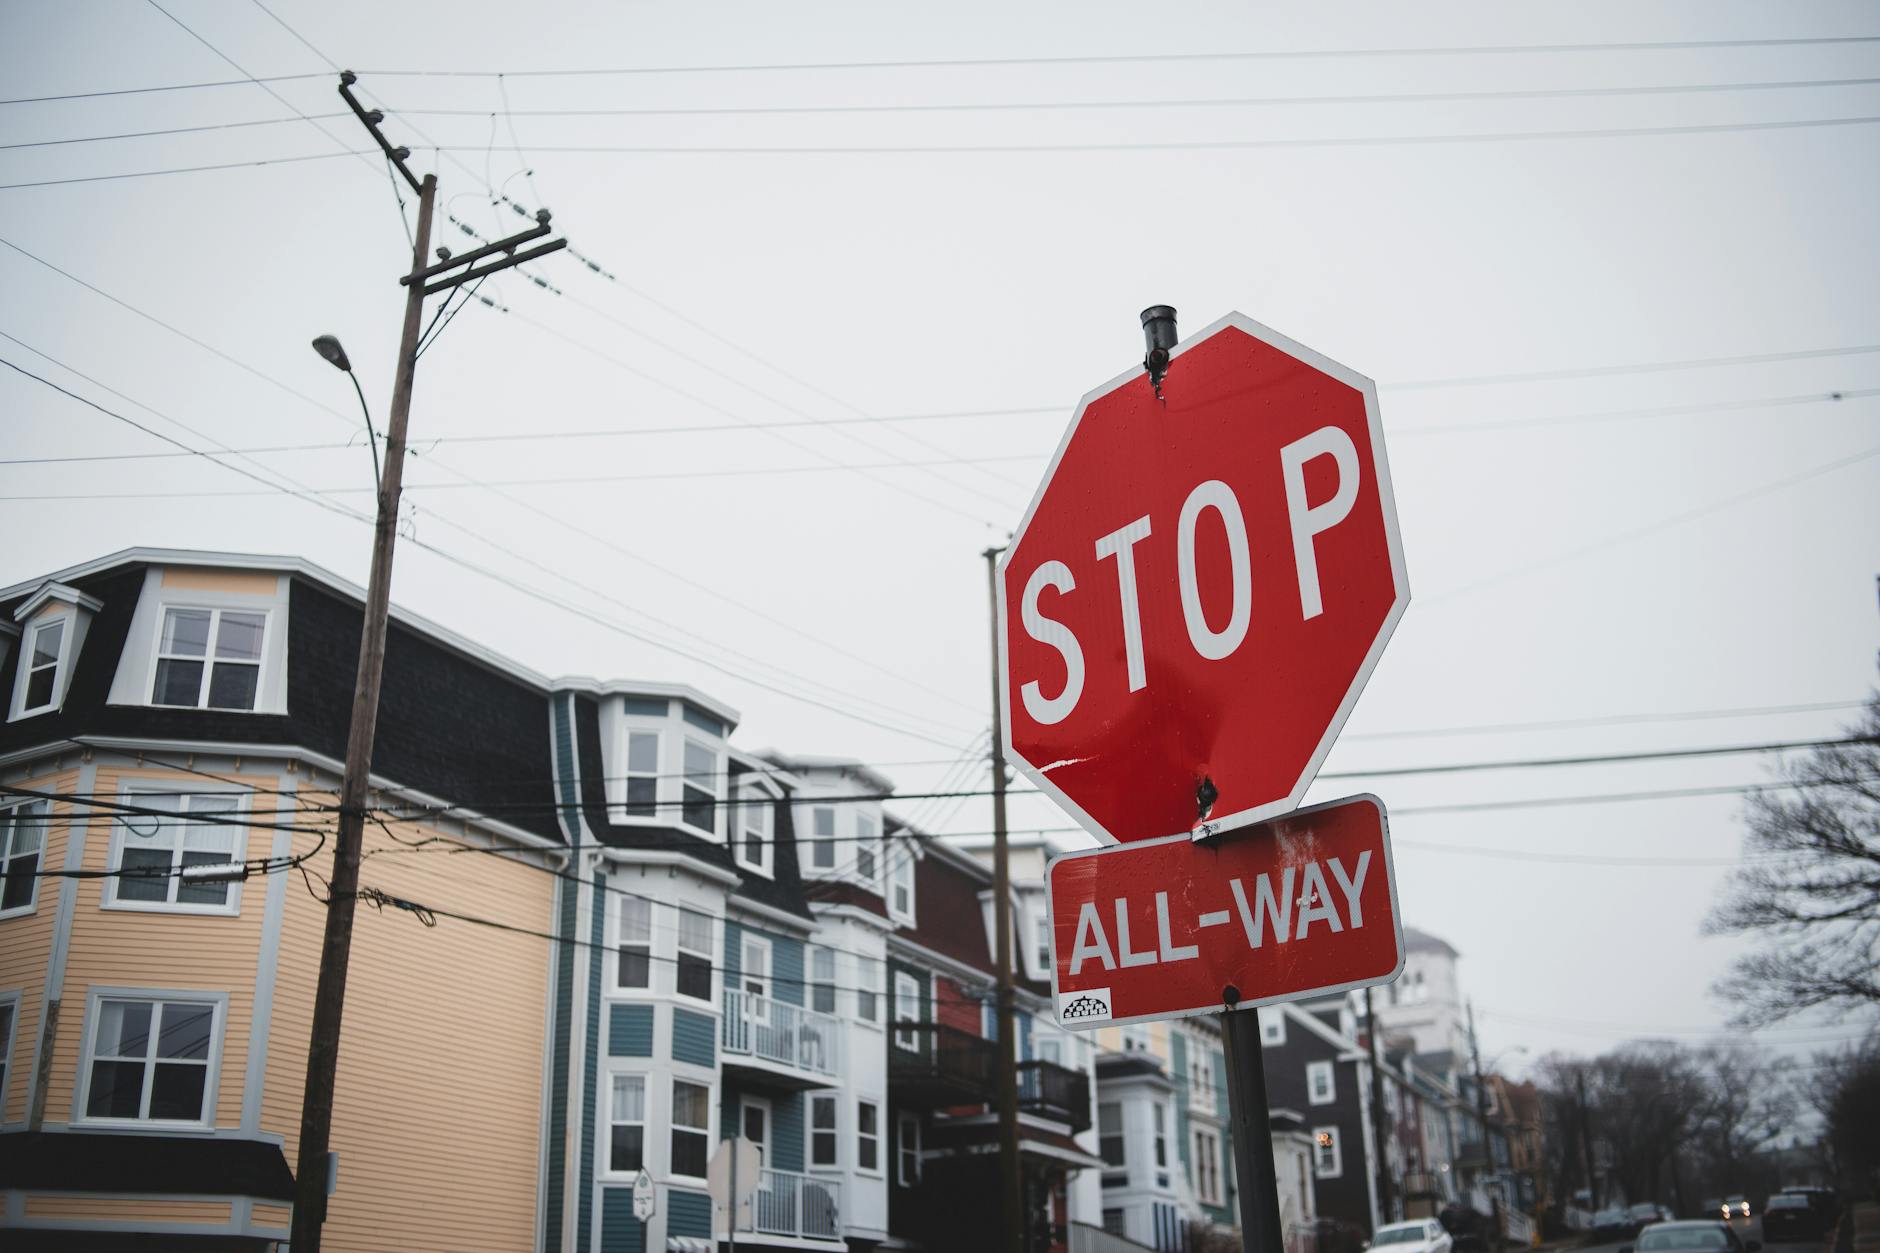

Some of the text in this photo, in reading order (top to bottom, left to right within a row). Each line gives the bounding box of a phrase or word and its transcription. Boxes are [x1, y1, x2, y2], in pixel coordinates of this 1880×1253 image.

[1020, 425, 1361, 725] STOP
[1068, 849, 1373, 976] ALL-WAY
[1064, 1008, 1107, 1018] SOUND
[1067, 1003, 1104, 1013] TOWN
